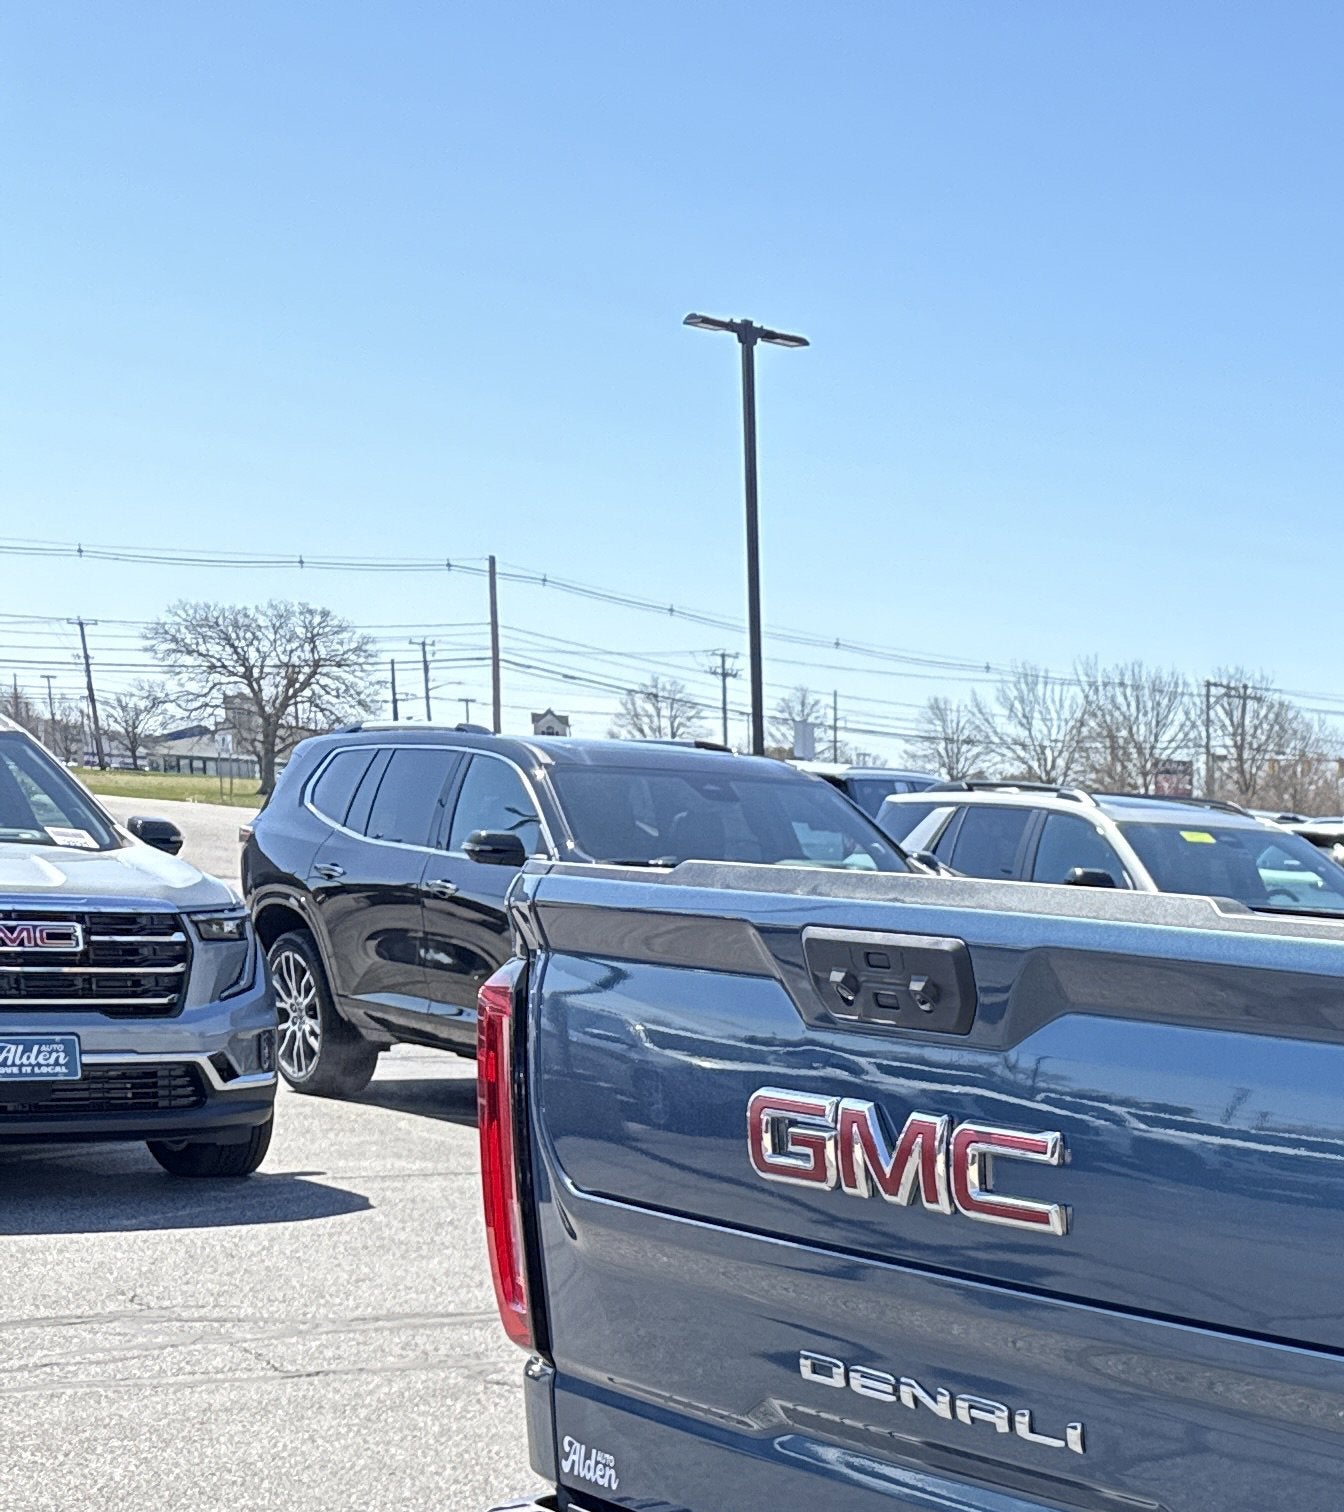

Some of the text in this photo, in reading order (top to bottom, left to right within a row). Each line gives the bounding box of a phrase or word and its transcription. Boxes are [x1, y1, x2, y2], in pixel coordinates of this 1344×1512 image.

[0, 1042, 70, 1066] Alden
[40, 1043, 65, 1052] AUTO
[22, 1066, 32, 1074] IT
[34, 1065, 69, 1074] LOCAL
[746, 1086, 1074, 1236] GMC
[799, 1350, 1087, 1454] DENALI
[561, 1435, 620, 1490] Alden
[596, 1450, 616, 1468] AUTO
